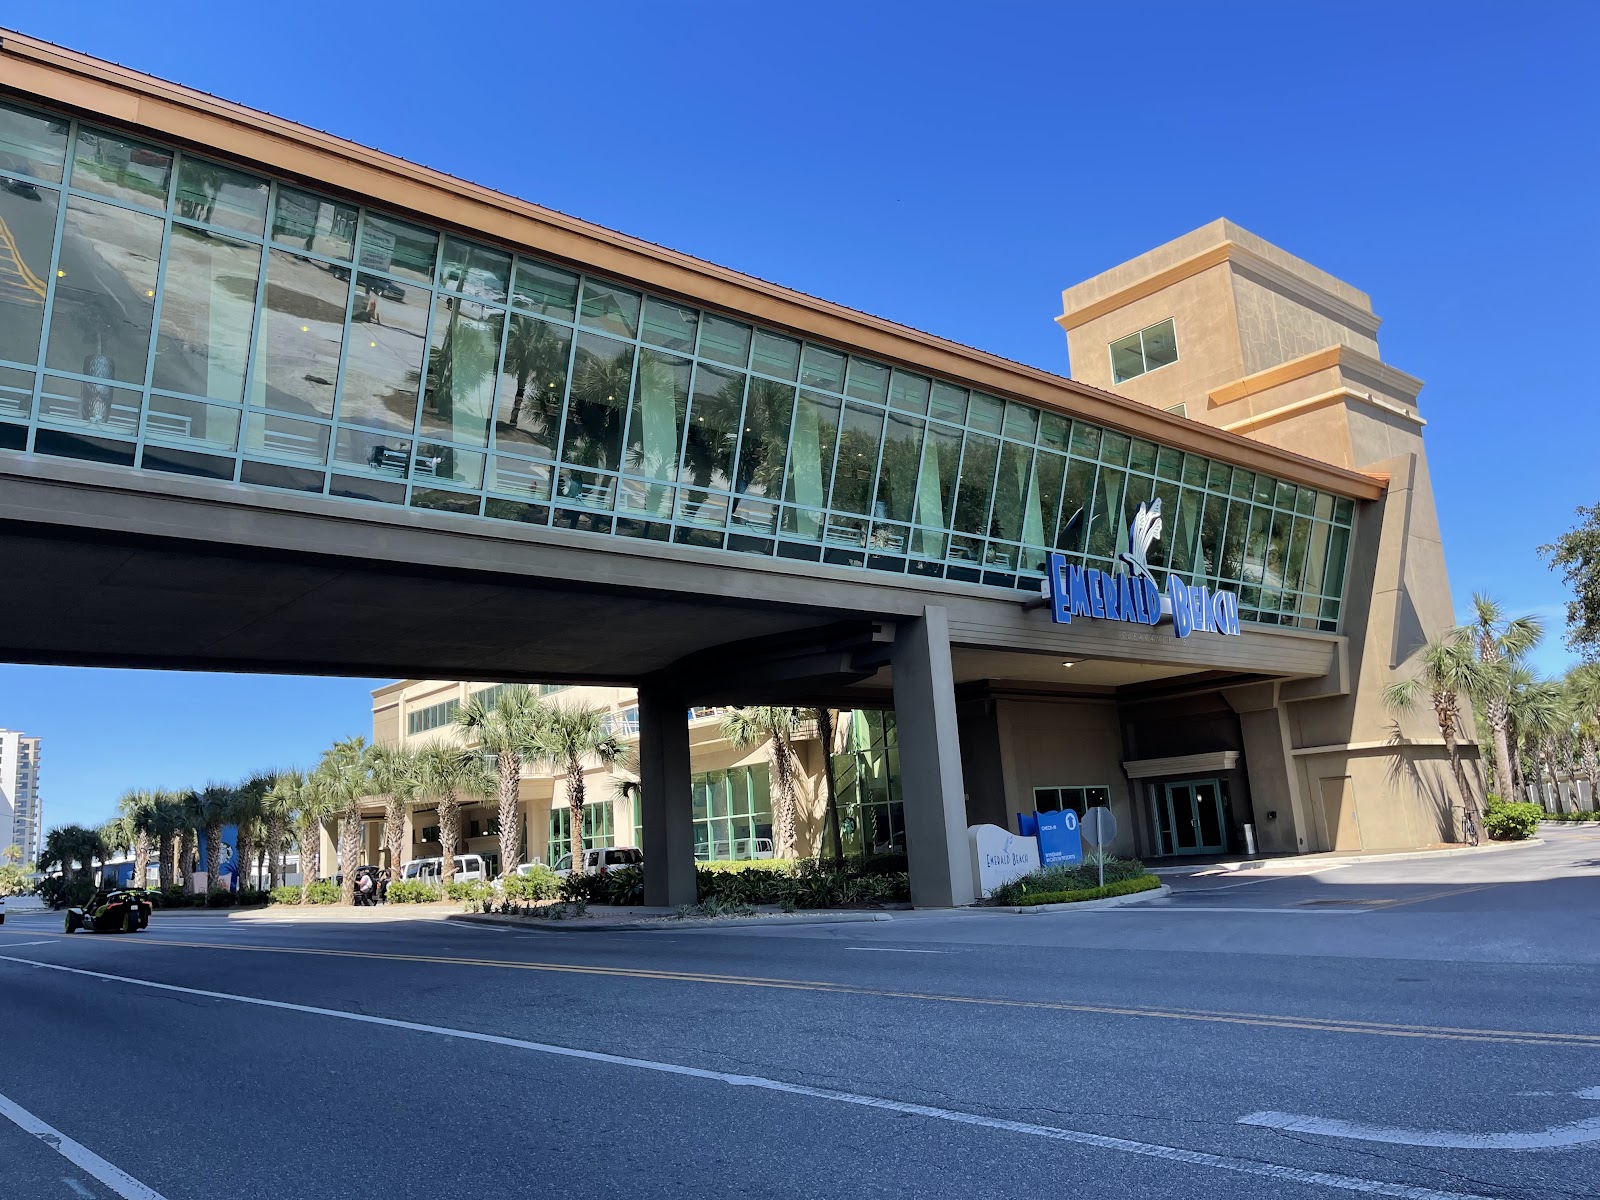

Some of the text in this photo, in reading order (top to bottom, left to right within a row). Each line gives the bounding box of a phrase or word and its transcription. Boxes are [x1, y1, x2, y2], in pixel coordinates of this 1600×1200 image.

[1048, 552, 1241, 638] EMERALD BEACH
[1121, 631, 1172, 644] CLEARANCE
[986, 852, 1028, 868] EMERALD BEACH
